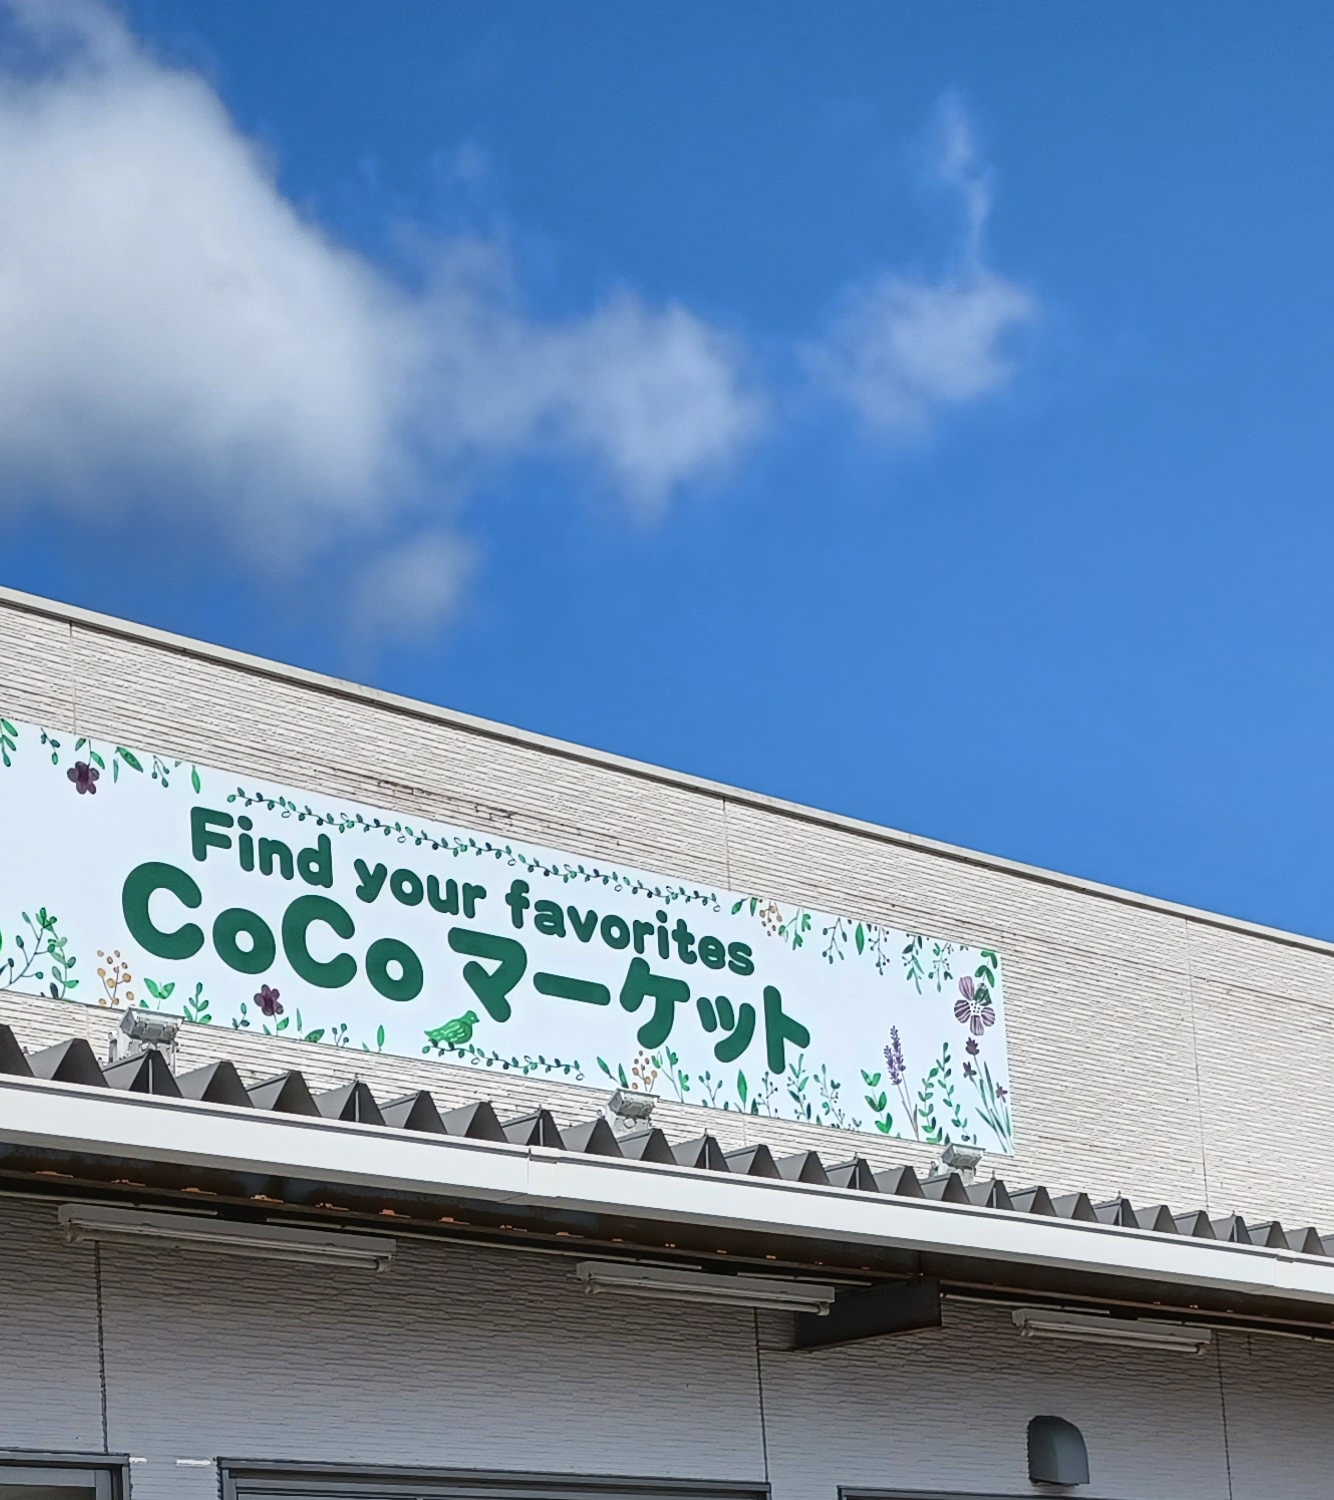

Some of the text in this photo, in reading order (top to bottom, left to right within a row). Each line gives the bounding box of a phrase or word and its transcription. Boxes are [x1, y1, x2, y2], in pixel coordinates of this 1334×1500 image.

[121, 861, 810, 1075] CoCo マーケット
[189, 806, 757, 978] Find your favorites
